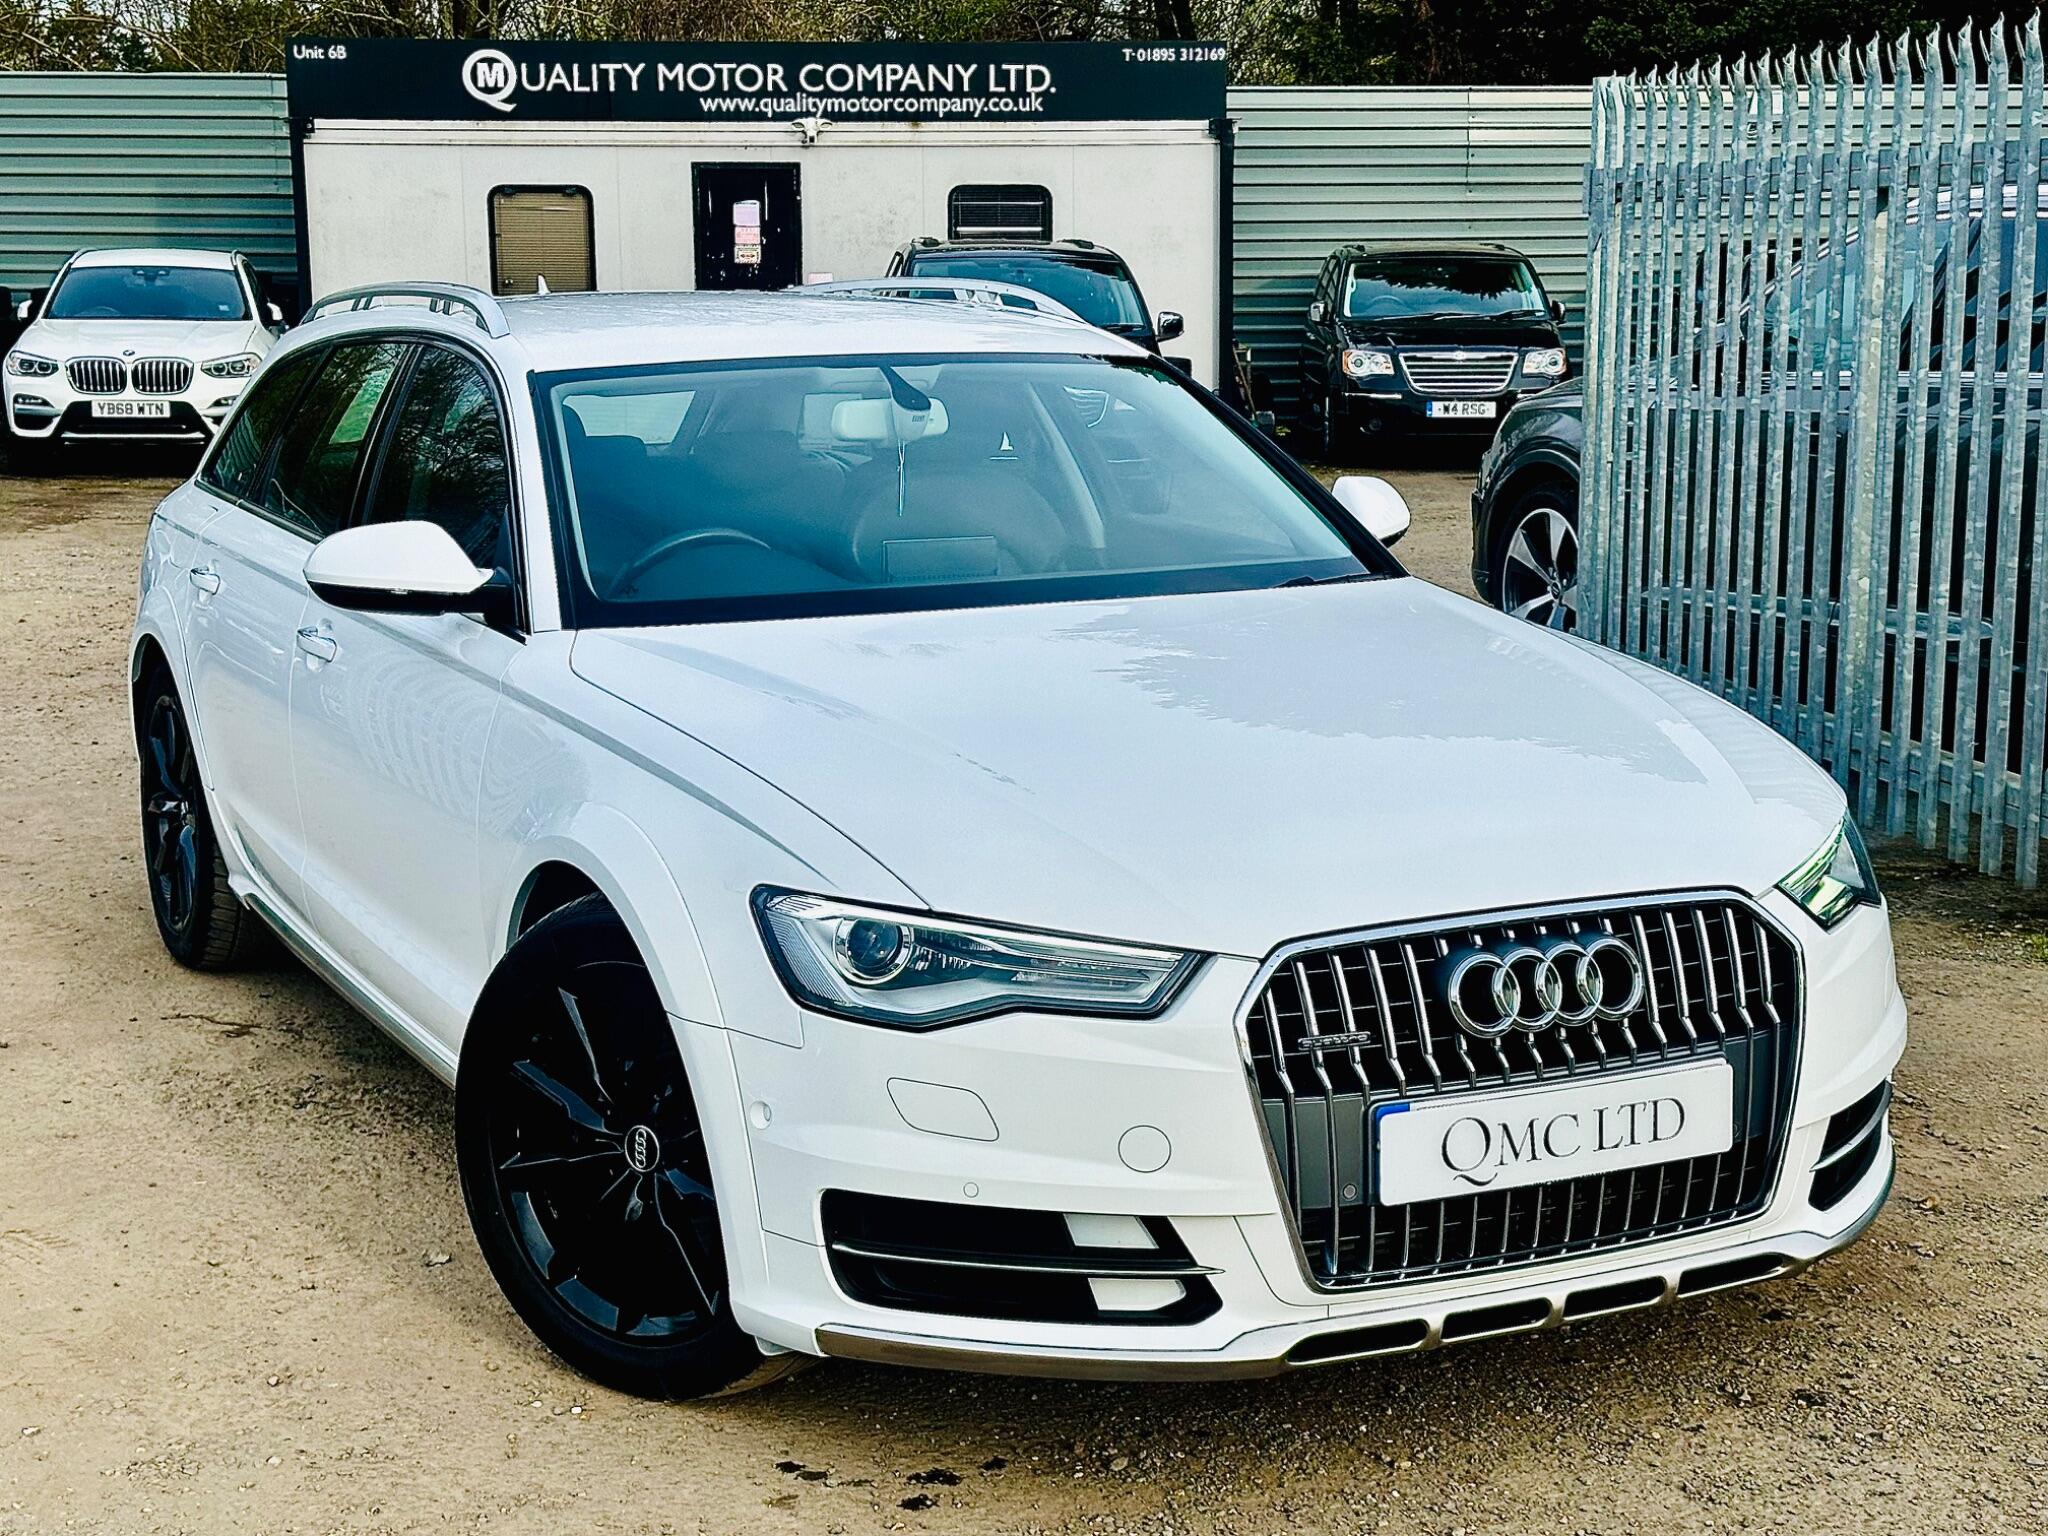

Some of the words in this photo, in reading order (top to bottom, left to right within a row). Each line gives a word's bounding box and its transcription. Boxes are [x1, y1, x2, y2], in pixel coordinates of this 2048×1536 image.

[293, 45, 325, 60] Unit
[327, 45, 347, 60] 6B
[1179, 47, 1226, 62] 312169
[462, 49, 646, 112] QUALITY
[657, 63, 788, 92] MOTOR
[798, 63, 978, 93] COMPANY
[988, 63, 1057, 93] LTD.
[700, 93, 1044, 117] www.qualitymotorcompany.co.uk
[97, 402, 134, 415] YB68
[136, 402, 164, 415] WTN
[1461, 403, 1486, 415] RSG
[1440, 1113, 1581, 1187] QMC
[1592, 1097, 1686, 1153] LTD
